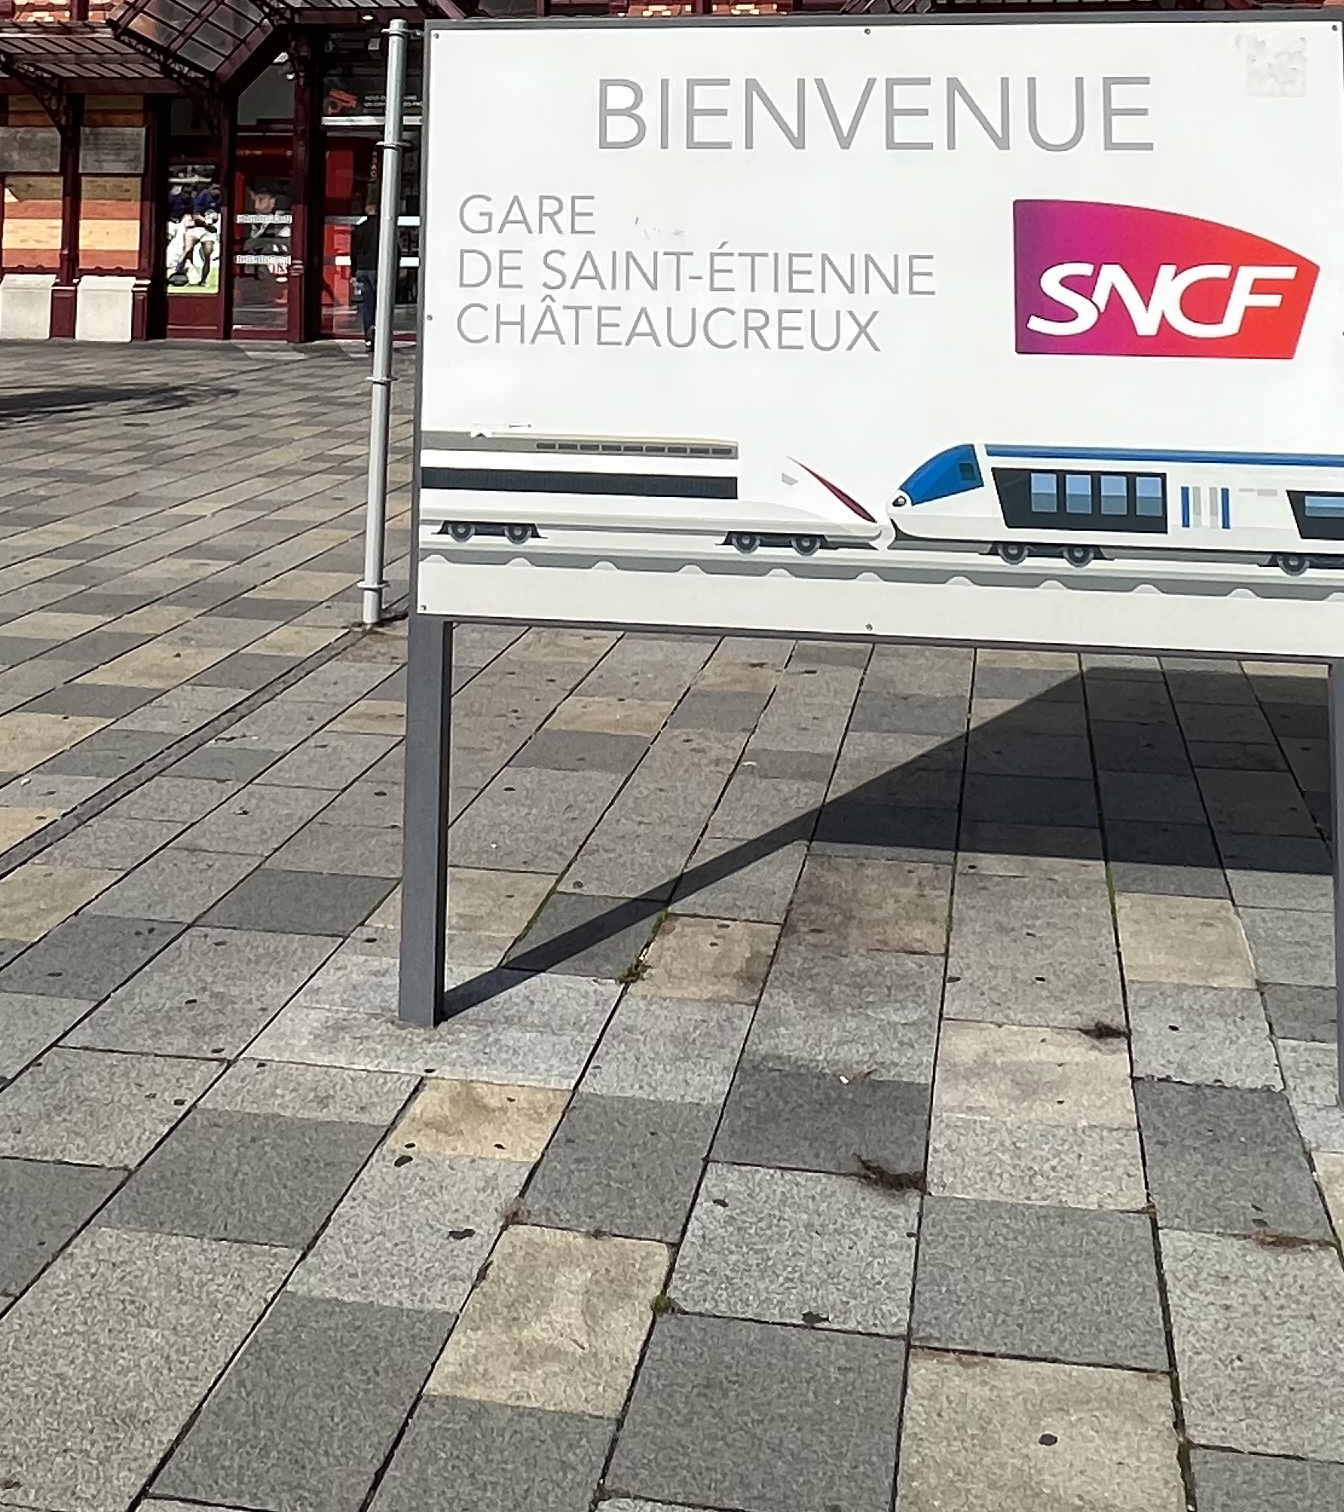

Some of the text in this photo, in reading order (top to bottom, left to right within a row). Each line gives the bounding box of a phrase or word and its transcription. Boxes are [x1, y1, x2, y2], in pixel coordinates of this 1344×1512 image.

[598, 76, 1154, 153] BIENVENUE
[458, 194, 596, 235] GARE
[458, 240, 937, 297] DE SAINT-ÉTIENNE
[456, 296, 881, 353] CHÂTEAUCREUX
[1026, 262, 1297, 339] SNCF
